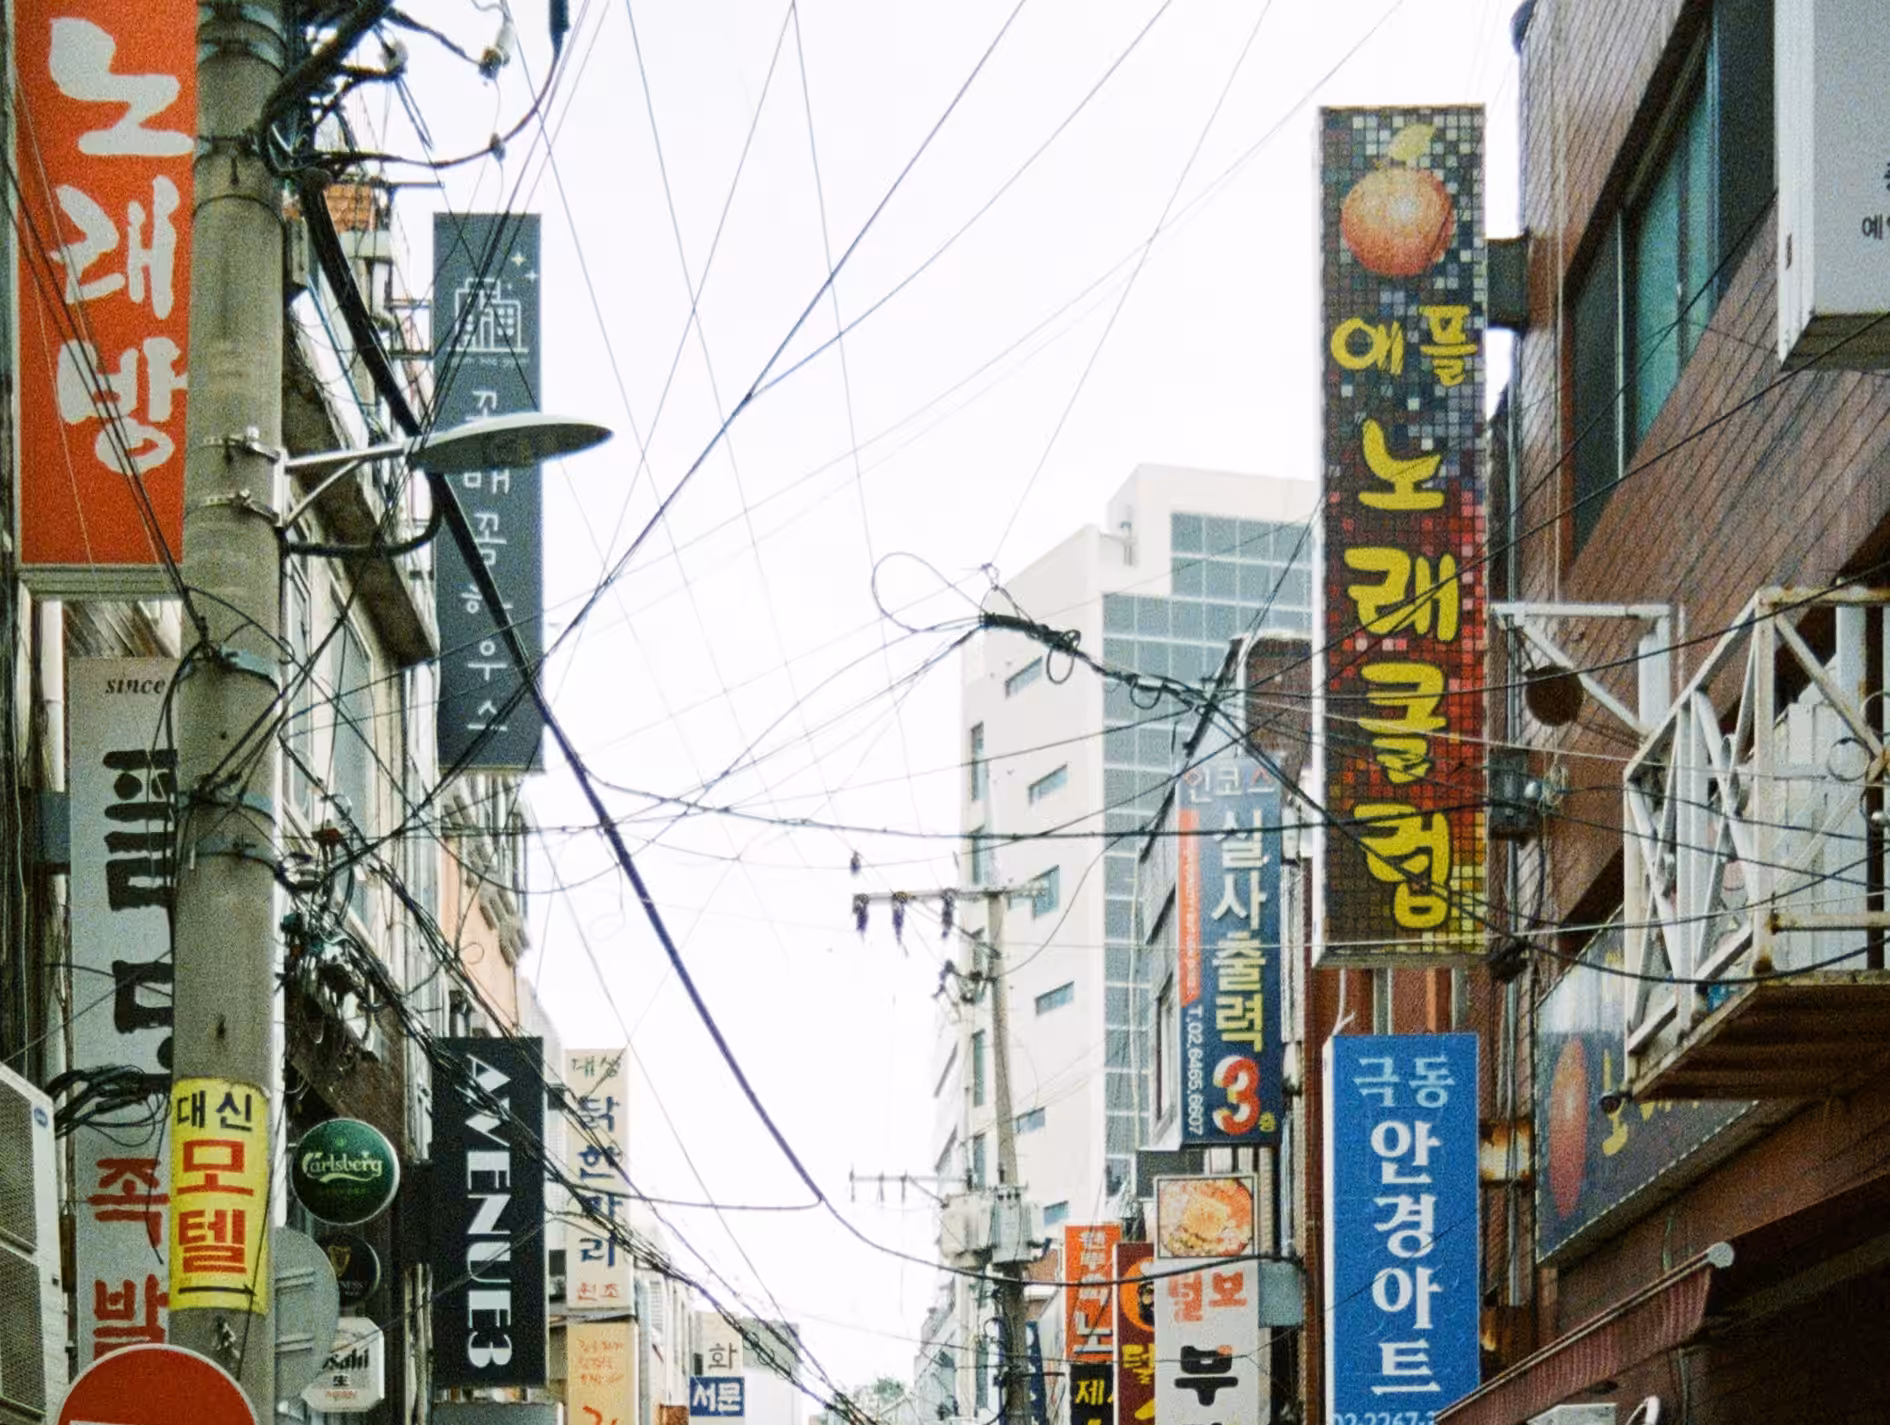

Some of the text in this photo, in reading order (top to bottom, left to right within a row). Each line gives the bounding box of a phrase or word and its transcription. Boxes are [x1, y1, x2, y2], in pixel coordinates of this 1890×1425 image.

[50, 17, 195, 475] 노래방
[105, 676, 166, 694] since
[1211, 809, 1267, 1052] 실사출력
[176, 1090, 252, 1132] 대신
[1354, 1057, 1455, 1108] 극동
[177, 1138, 253, 1274] 모텔
[302, 1151, 383, 1180] Carlsberg
[1370, 1119, 1442, 1395] 안경아트
